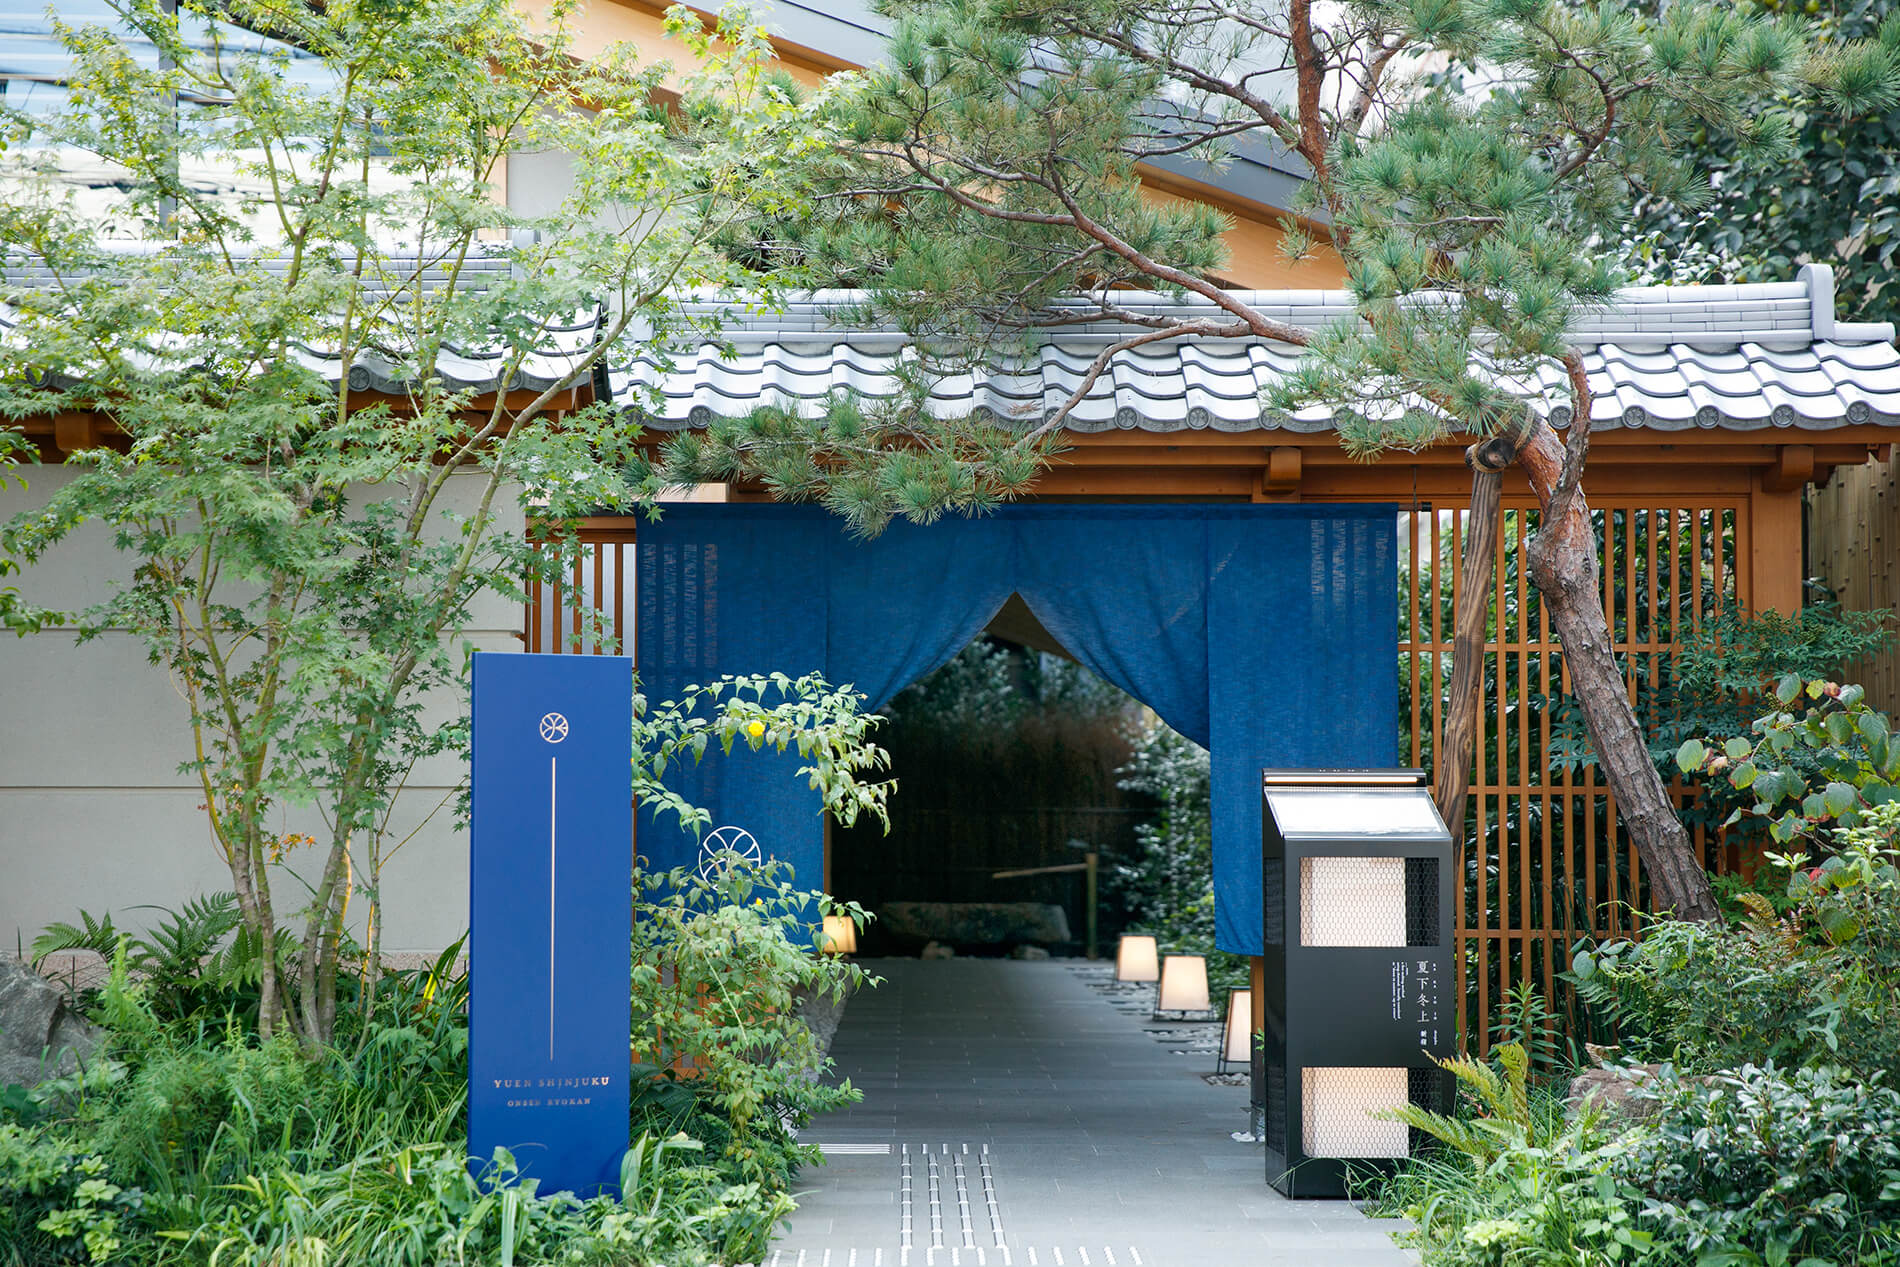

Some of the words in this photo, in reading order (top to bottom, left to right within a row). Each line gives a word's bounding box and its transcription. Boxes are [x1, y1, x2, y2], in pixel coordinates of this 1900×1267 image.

[1416, 960, 1429, 1022] 夏下冬上
[494, 1079, 532, 1088] YUEN
[538, 1076, 609, 1088] SHINJUKU
